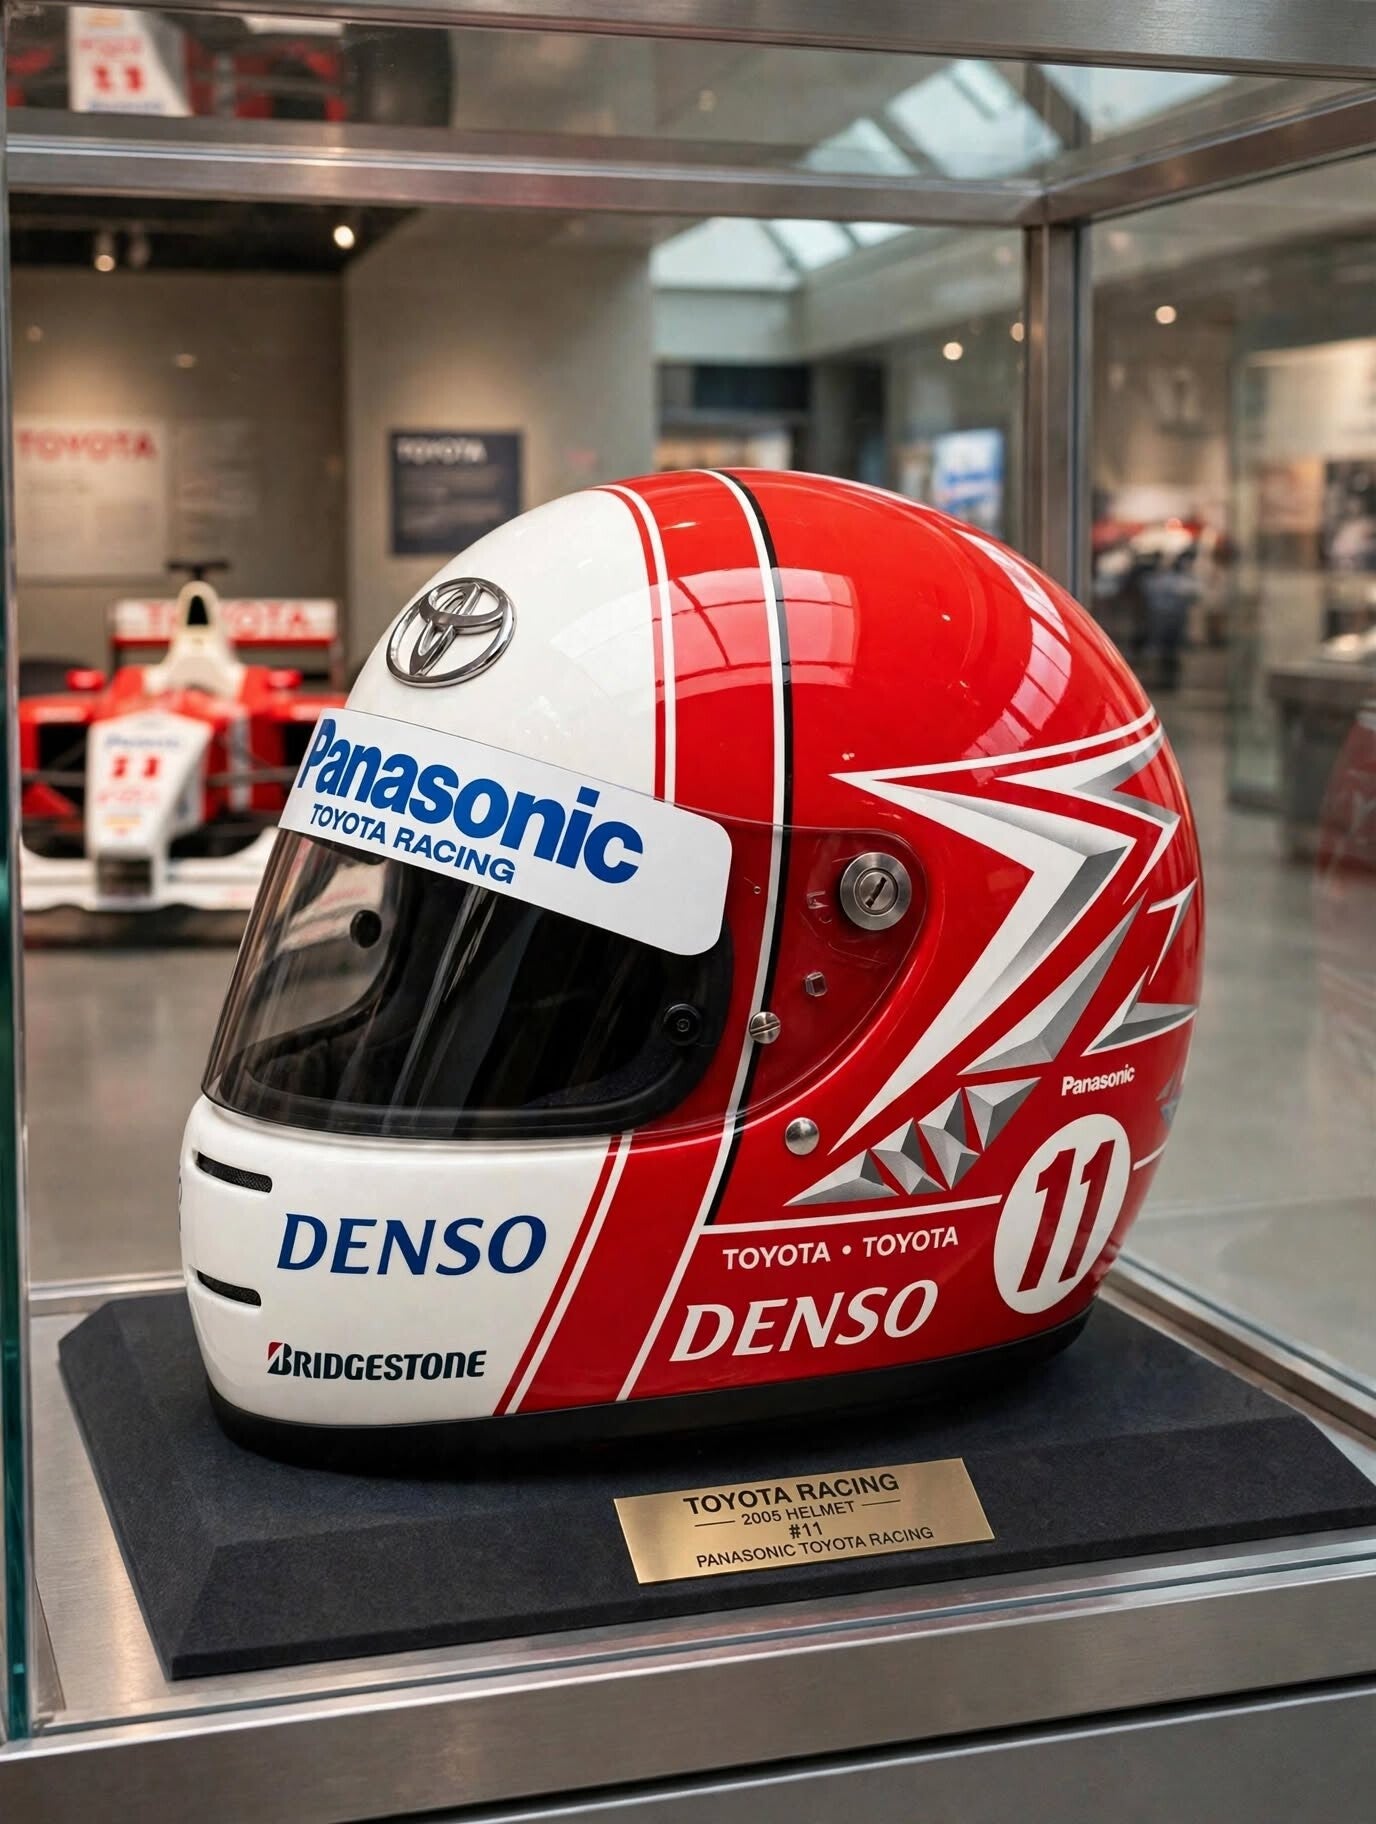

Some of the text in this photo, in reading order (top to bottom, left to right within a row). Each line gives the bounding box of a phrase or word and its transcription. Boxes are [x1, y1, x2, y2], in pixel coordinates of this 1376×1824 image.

[297, 718, 644, 884] Panasonic
[310, 803, 516, 885] TOYOTA RACING
[1061, 1063, 1136, 1096] Panasonic
[1016, 1138, 1117, 1294] 11
[277, 1213, 547, 1276] DENSO
[722, 1226, 959, 1270] TOYOTA TOYOTA
[669, 1279, 938, 1362] DENSO
[267, 1341, 487, 1381] BRIDGESTONE
[683, 1472, 900, 1516] TOYOTA RACING
[741, 1500, 856, 1526] 2005 HELMET
[696, 1525, 935, 1569] PANASONIC TOYOTA RACING
[789, 1521, 823, 1540] #11
